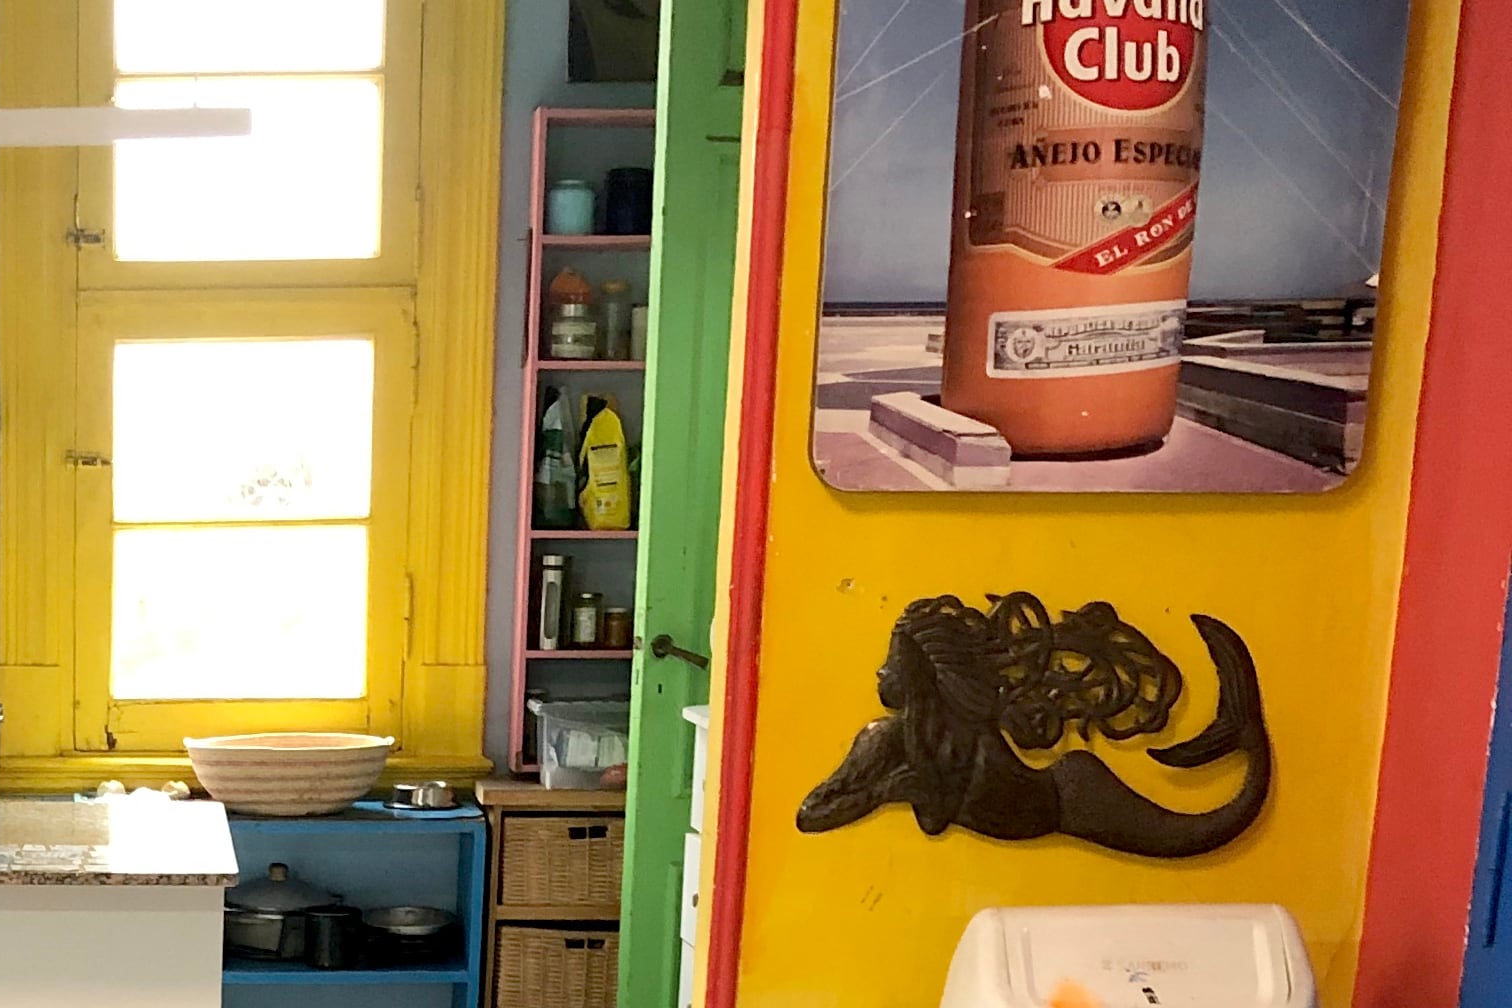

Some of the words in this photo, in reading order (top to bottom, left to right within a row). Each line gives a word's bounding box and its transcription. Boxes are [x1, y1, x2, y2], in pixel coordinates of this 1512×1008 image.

[1064, 26, 1181, 82] Club
[1010, 137, 1101, 170] AÑEJO
[1094, 244, 1129, 268] EL
[1133, 213, 1174, 247] RON
